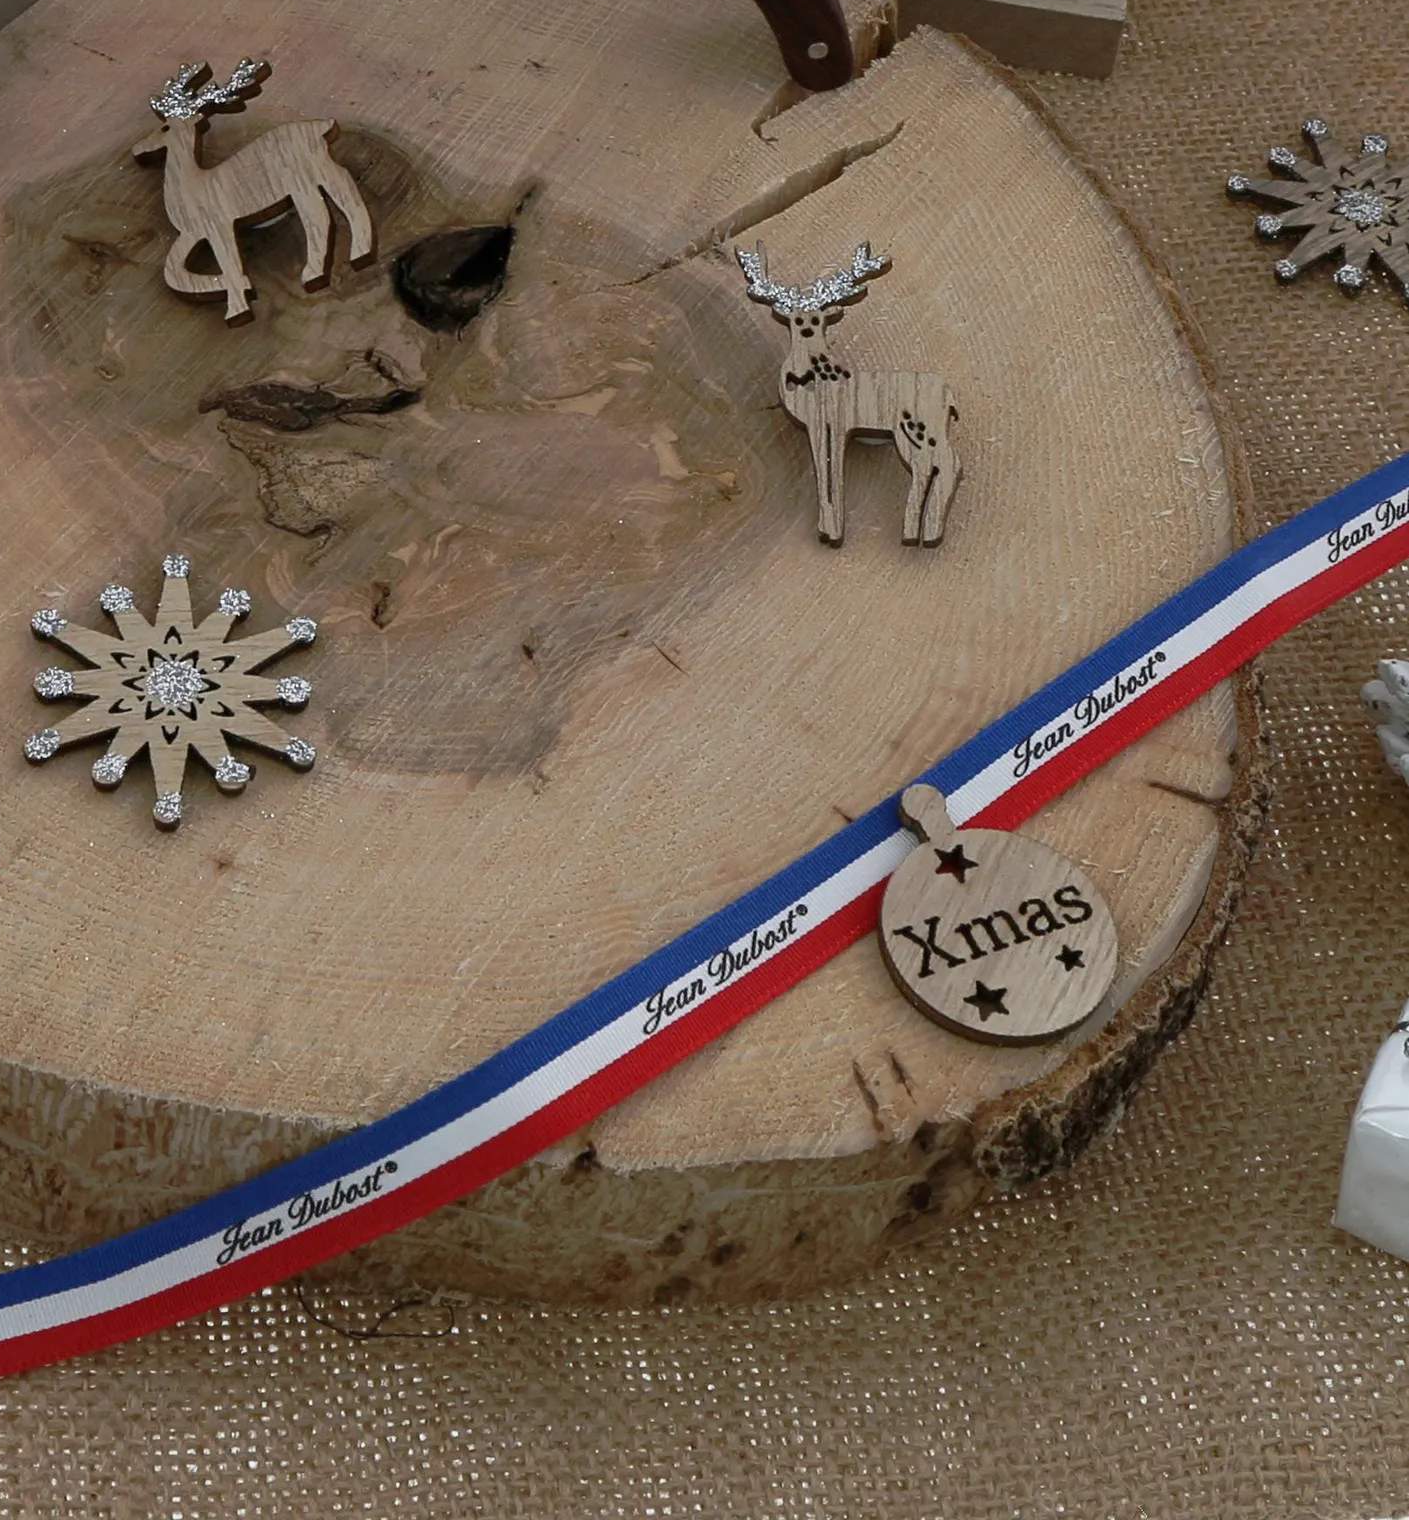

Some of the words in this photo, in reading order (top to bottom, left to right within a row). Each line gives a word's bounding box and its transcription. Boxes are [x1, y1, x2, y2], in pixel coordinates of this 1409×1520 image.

[1327, 522, 1375, 563] Jean
[1013, 722, 1075, 778] Jean
[892, 884, 1093, 979] Xmas
[642, 978, 707, 1035] Jean
[216, 1216, 284, 1266] Jean
